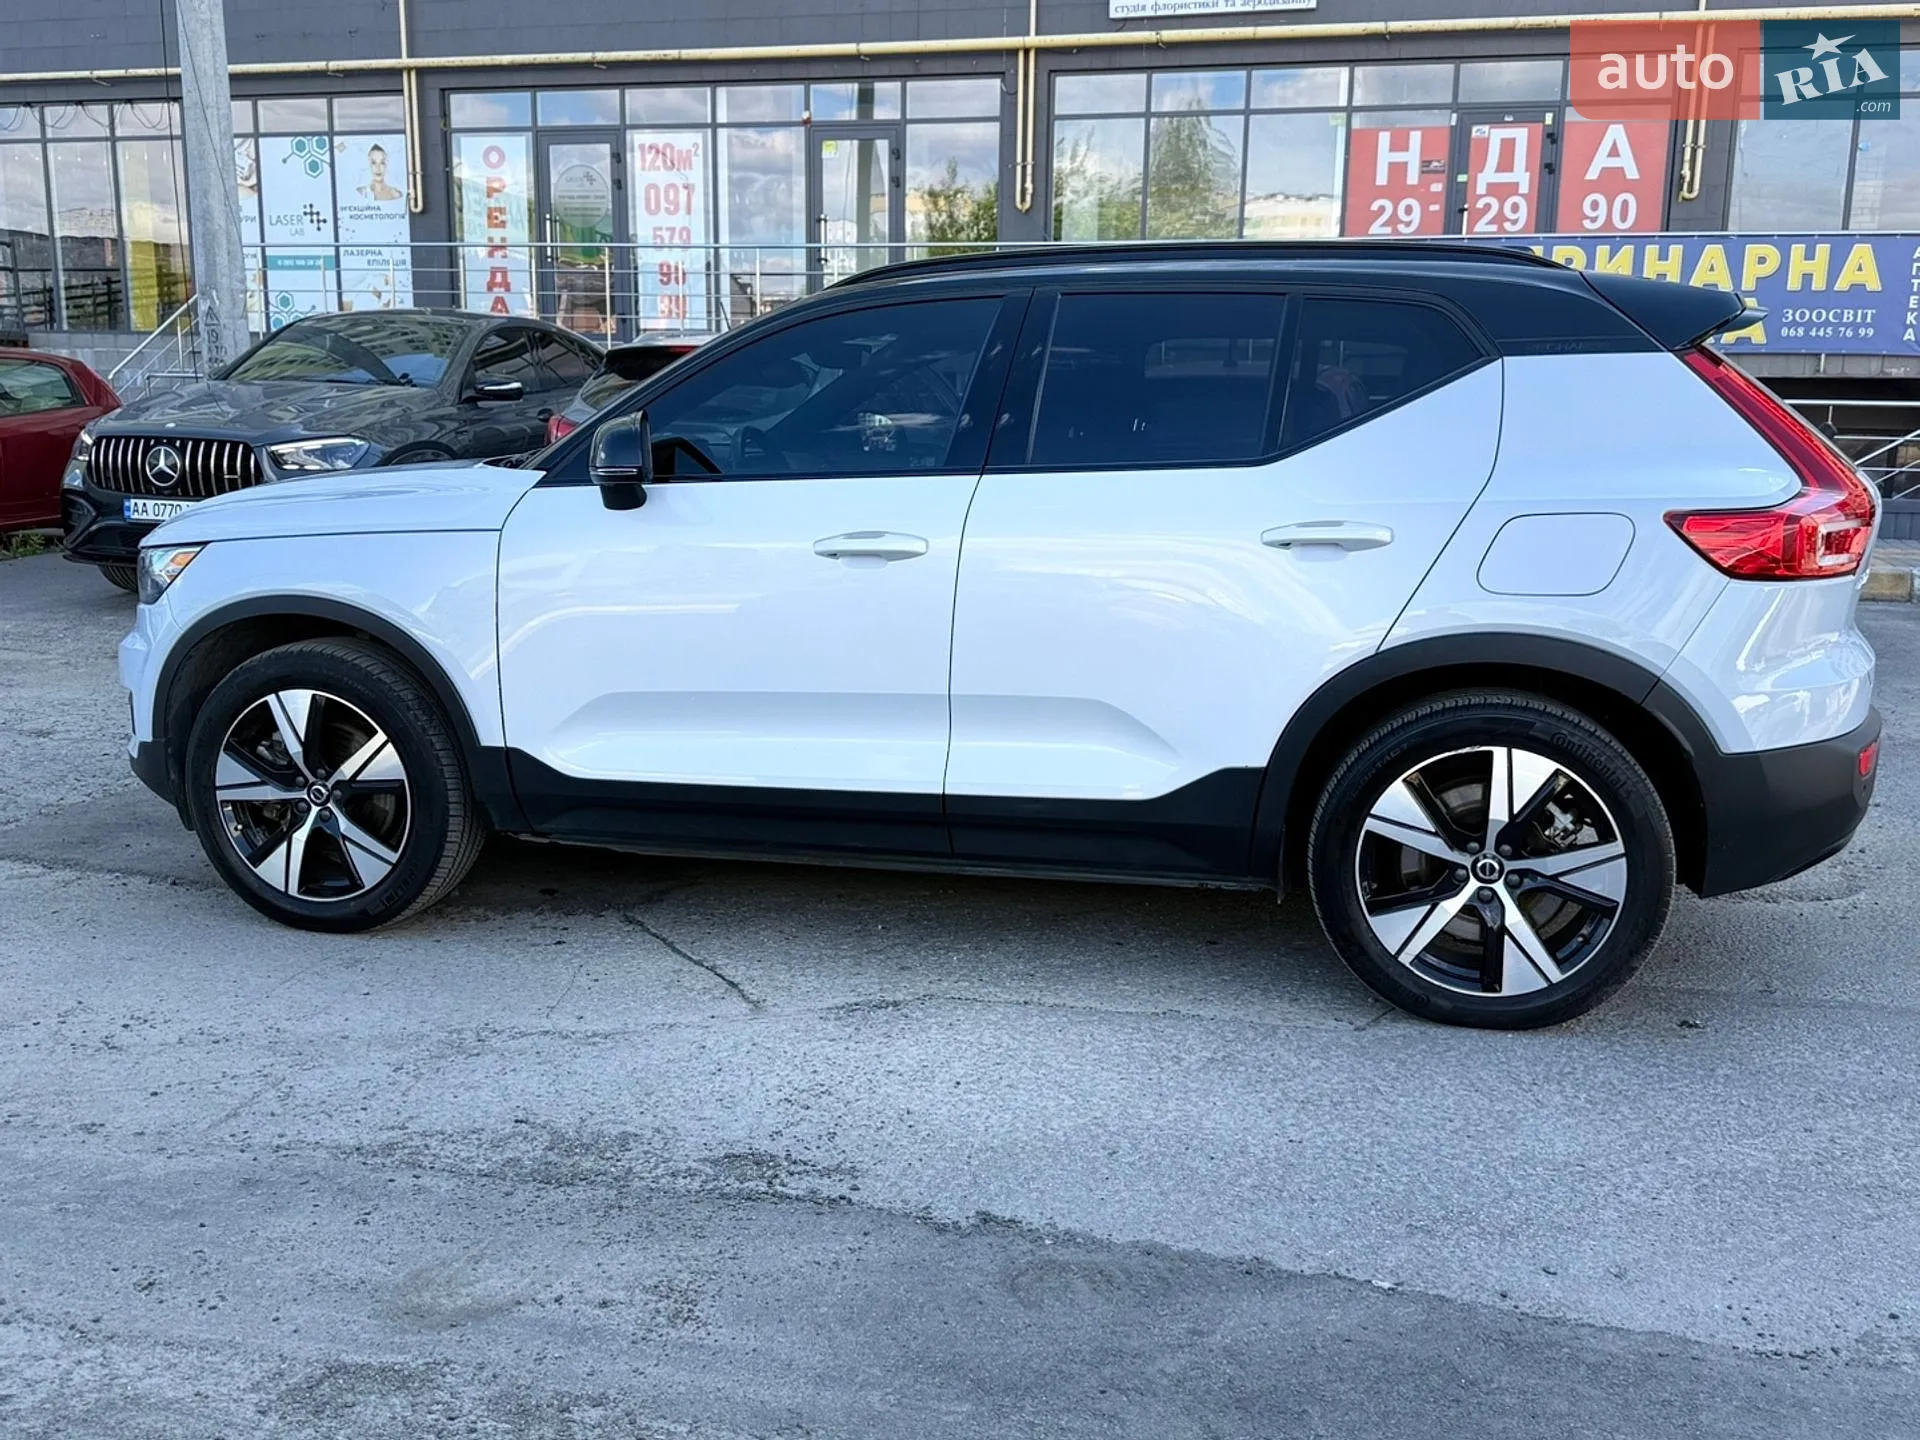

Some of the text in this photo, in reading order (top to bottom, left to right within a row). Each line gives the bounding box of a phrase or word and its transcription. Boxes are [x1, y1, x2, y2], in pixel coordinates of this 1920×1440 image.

[643, 182, 696, 216] 097
[268, 214, 304, 226] LASER
[1367, 192, 1638, 235] 29 29 90
[289, 227, 305, 237] LAB
[652, 226, 692, 252] 579
[343, 249, 384, 257] ЛАЗЕРНА
[1528, 244, 1883, 292] РИНАРНА
[1782, 308, 1877, 323] ЗООСВІТ
[1781, 326, 1875, 338] 068 445 76 99
